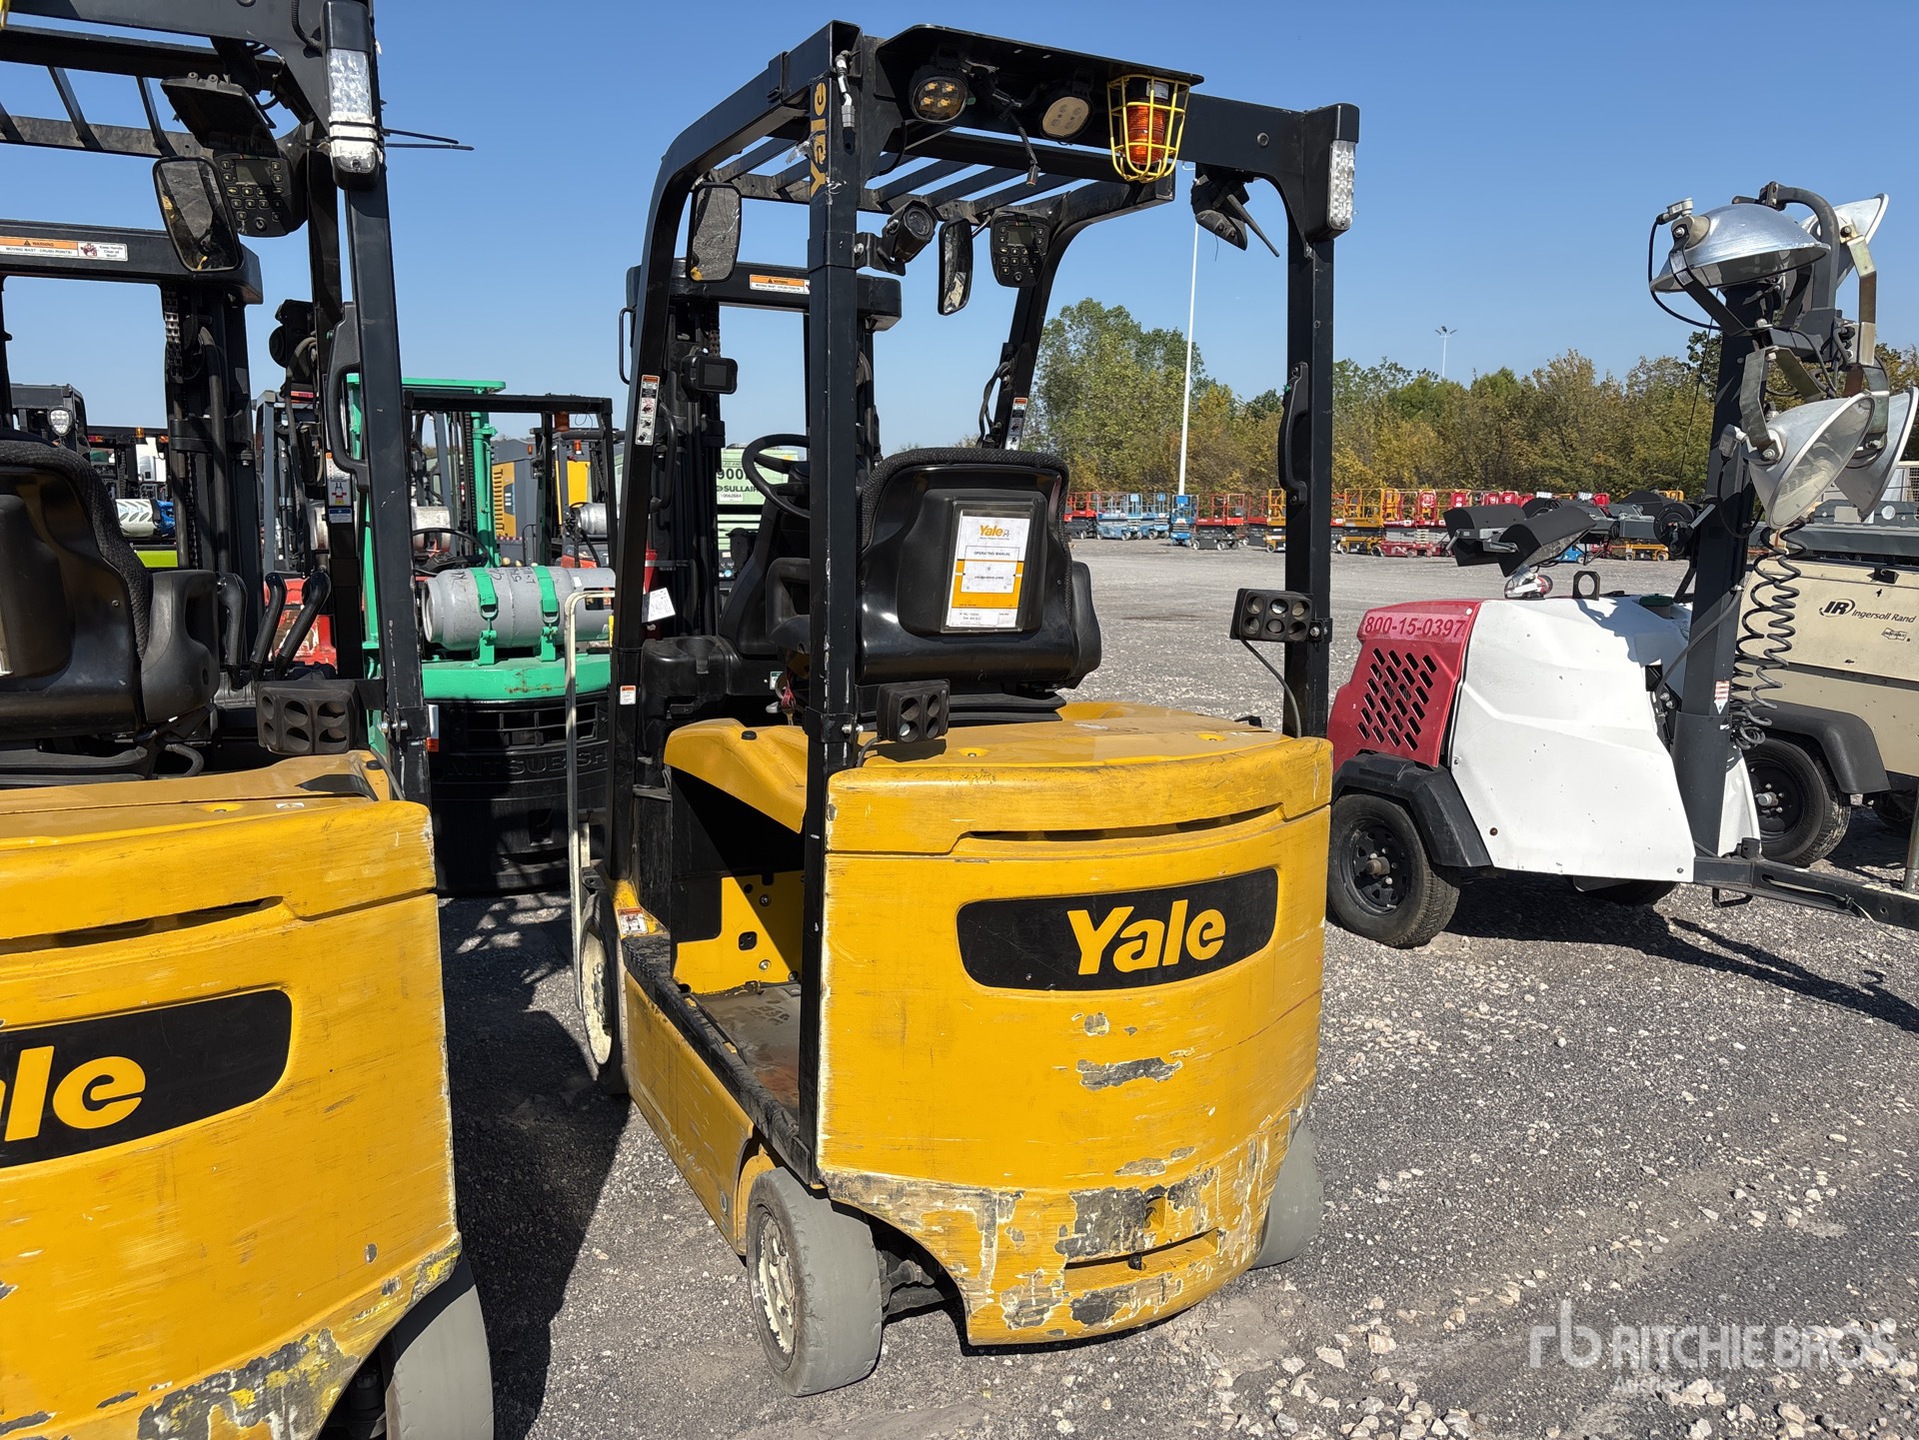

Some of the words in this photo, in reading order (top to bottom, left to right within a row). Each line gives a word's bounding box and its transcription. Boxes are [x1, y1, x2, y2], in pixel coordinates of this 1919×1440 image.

[717, 468, 748, 480] 900
[980, 525, 1003, 537] Yale
[1824, 601, 1850, 615] IR
[1852, 609, 1891, 620] Ingersoll
[1891, 613, 1917, 623] Rand
[1364, 616, 1466, 637] 800-15-0397
[1067, 899, 1226, 975] Yale
